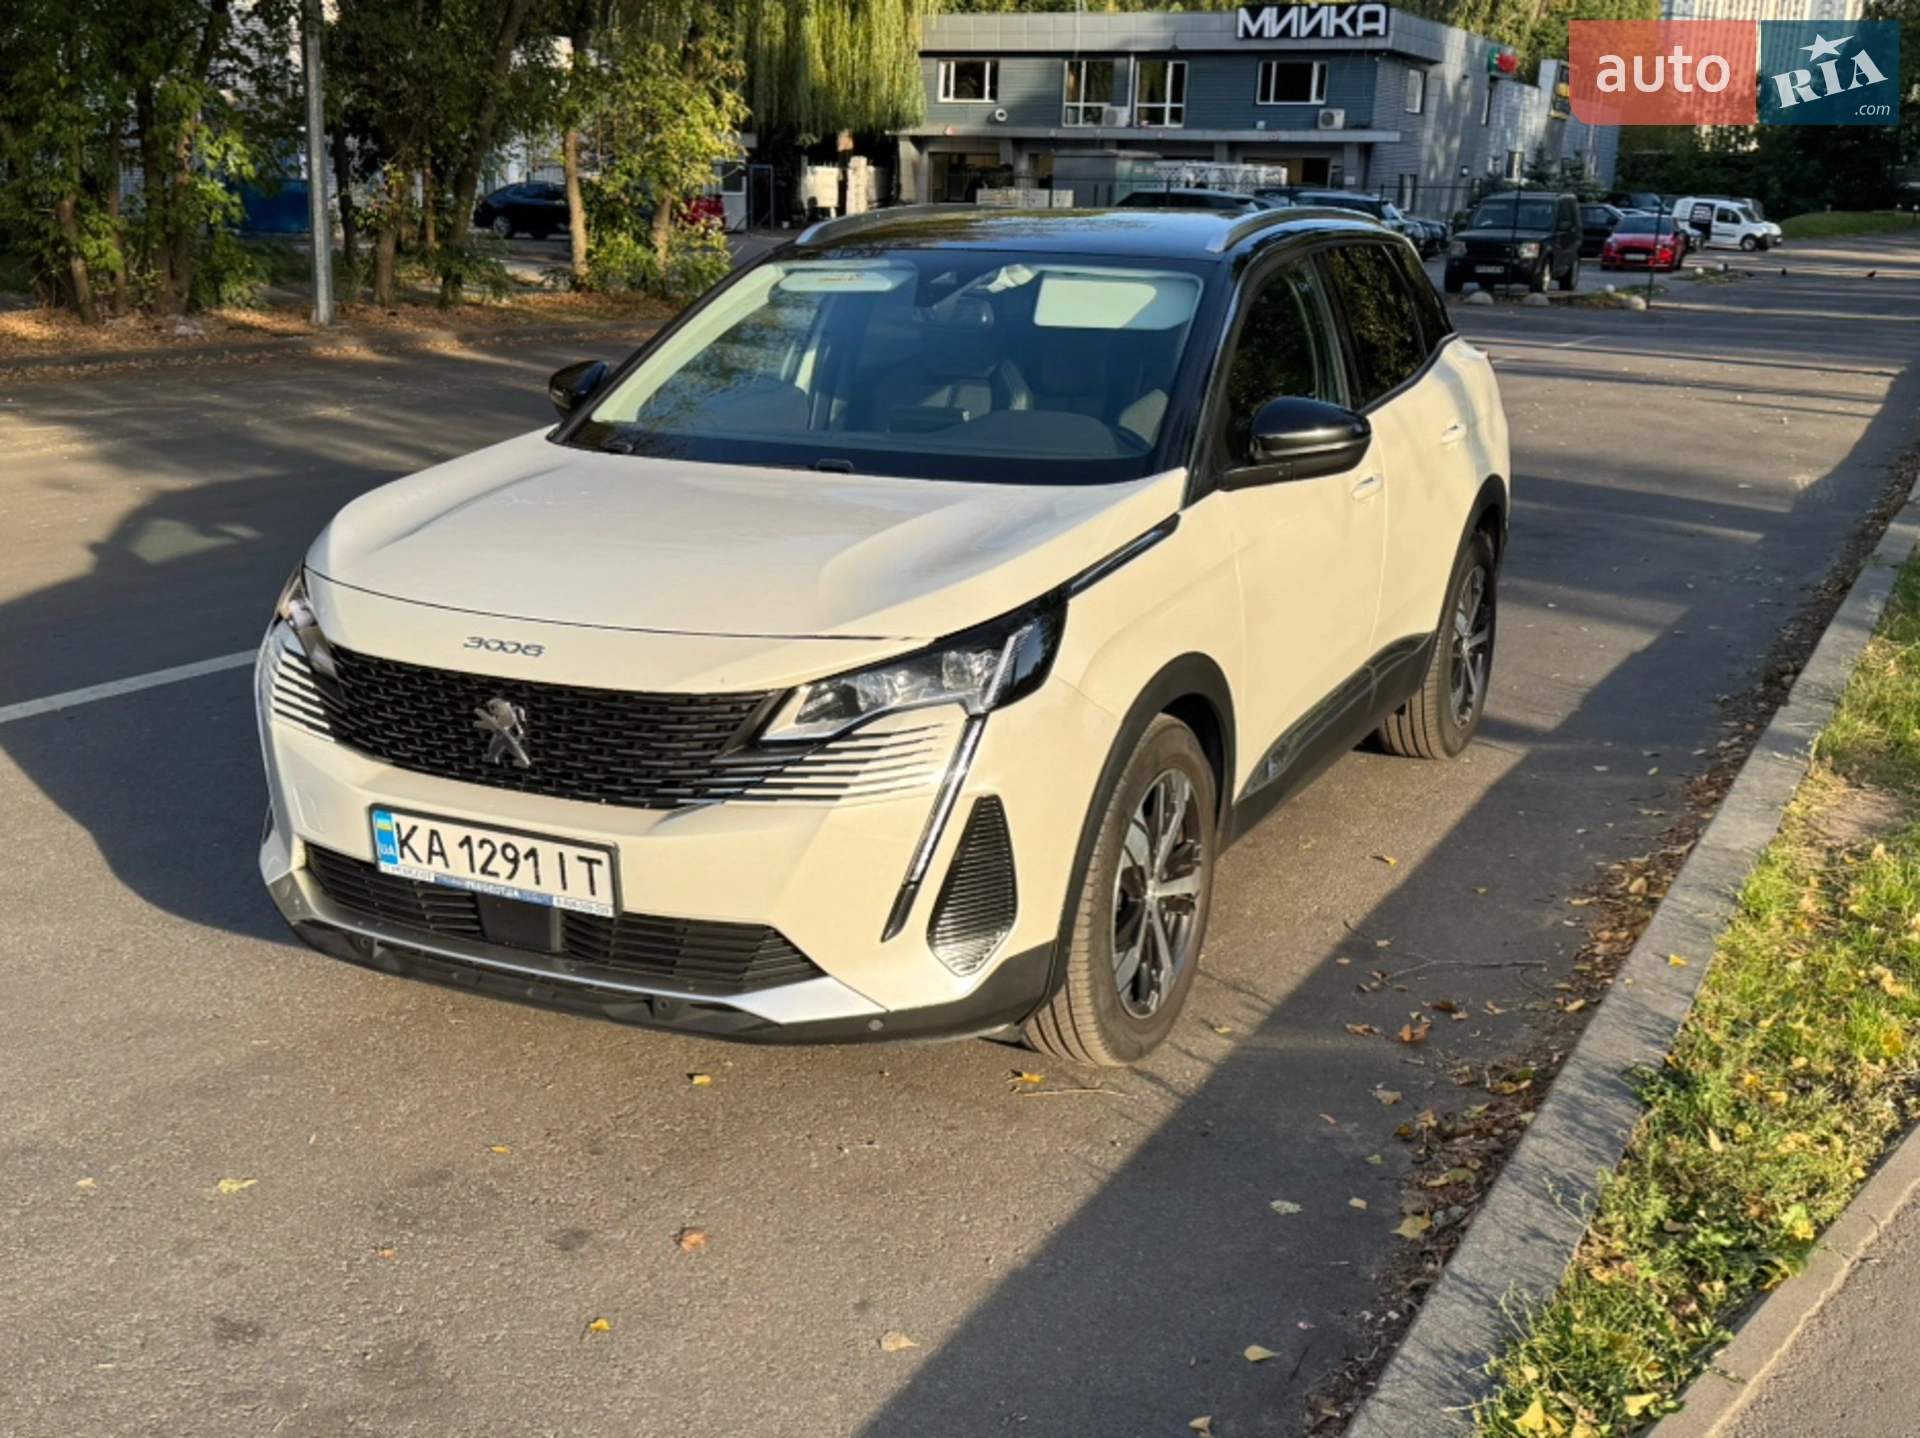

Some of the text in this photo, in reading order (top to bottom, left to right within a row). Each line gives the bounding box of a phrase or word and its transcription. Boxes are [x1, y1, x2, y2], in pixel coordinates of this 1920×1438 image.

[1238, 3, 1387, 38] МИЙКА
[380, 844, 396, 857] UA
[395, 822, 450, 868] KA
[458, 835, 541, 885] 1291
[559, 852, 603, 896] IT
